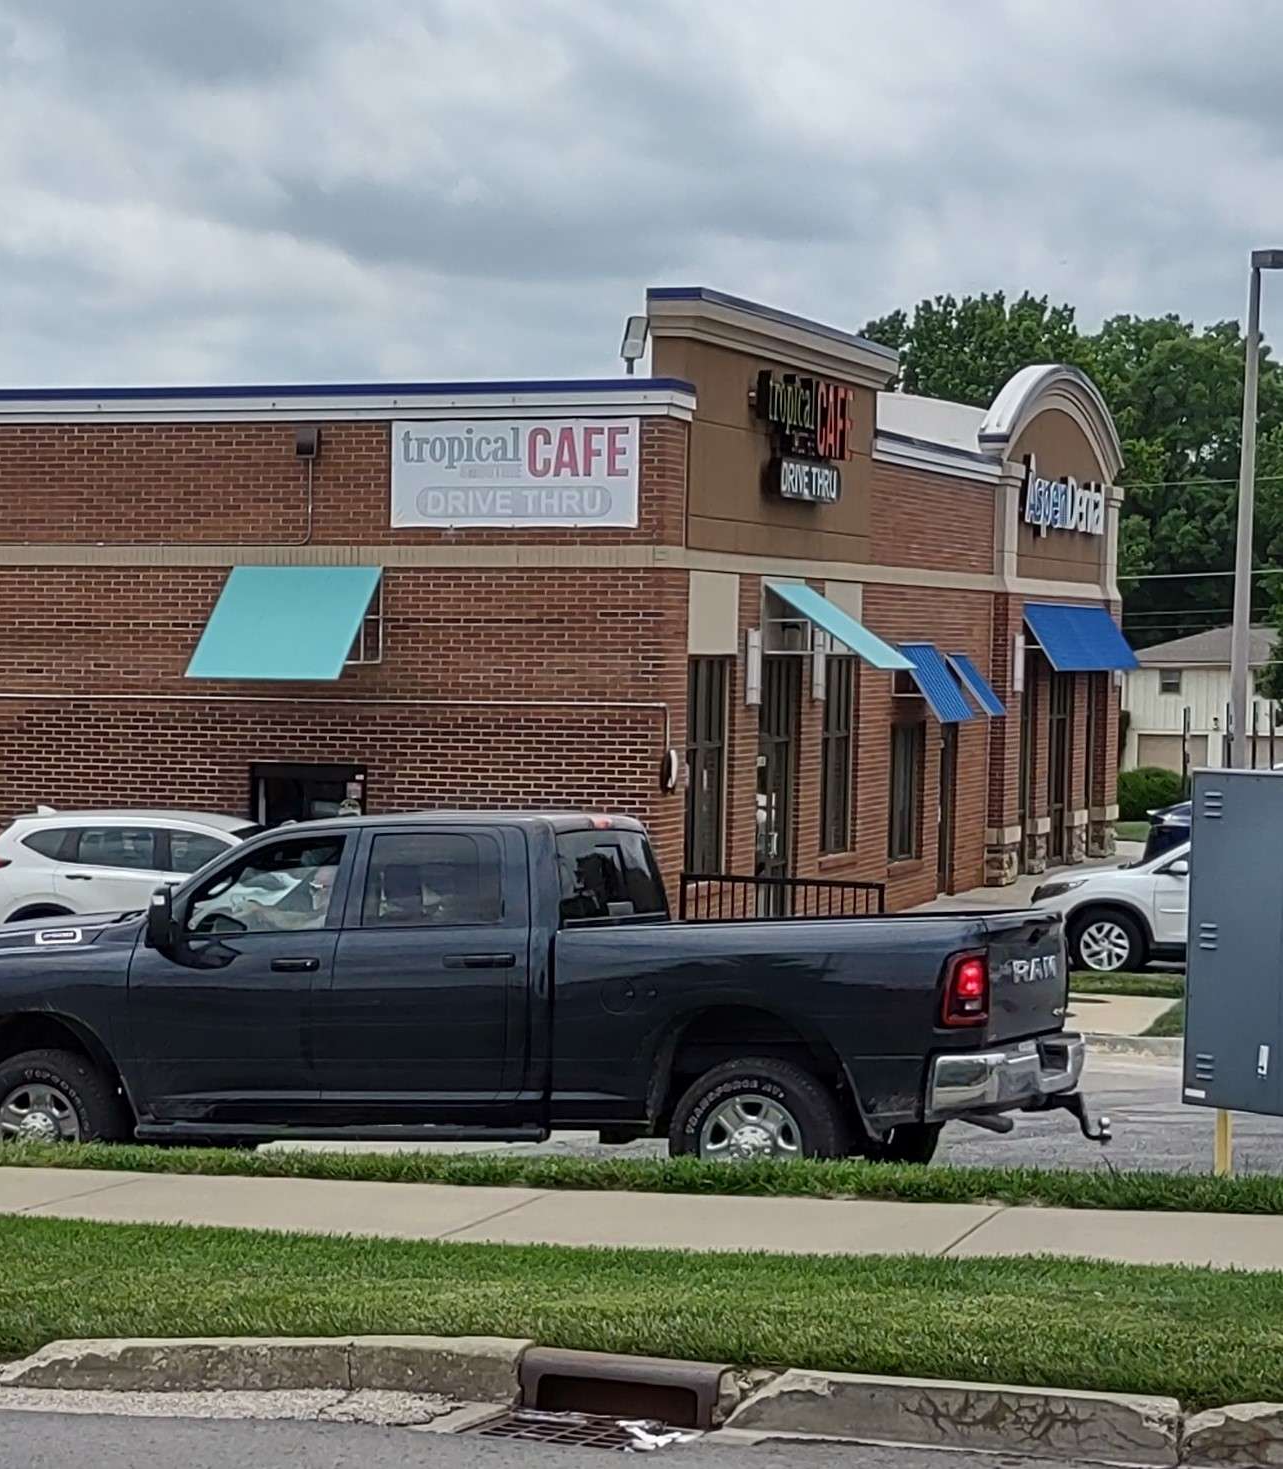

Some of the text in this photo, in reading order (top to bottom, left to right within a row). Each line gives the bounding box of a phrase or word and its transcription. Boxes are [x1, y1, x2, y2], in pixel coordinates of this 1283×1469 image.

[769, 375, 854, 462] tropical CAFE
[402, 426, 629, 478] tropical CAFE
[781, 461, 837, 499] DRIVE THRU
[427, 489, 602, 515] DRIVE THRU
[1013, 955, 1058, 984] RAM
